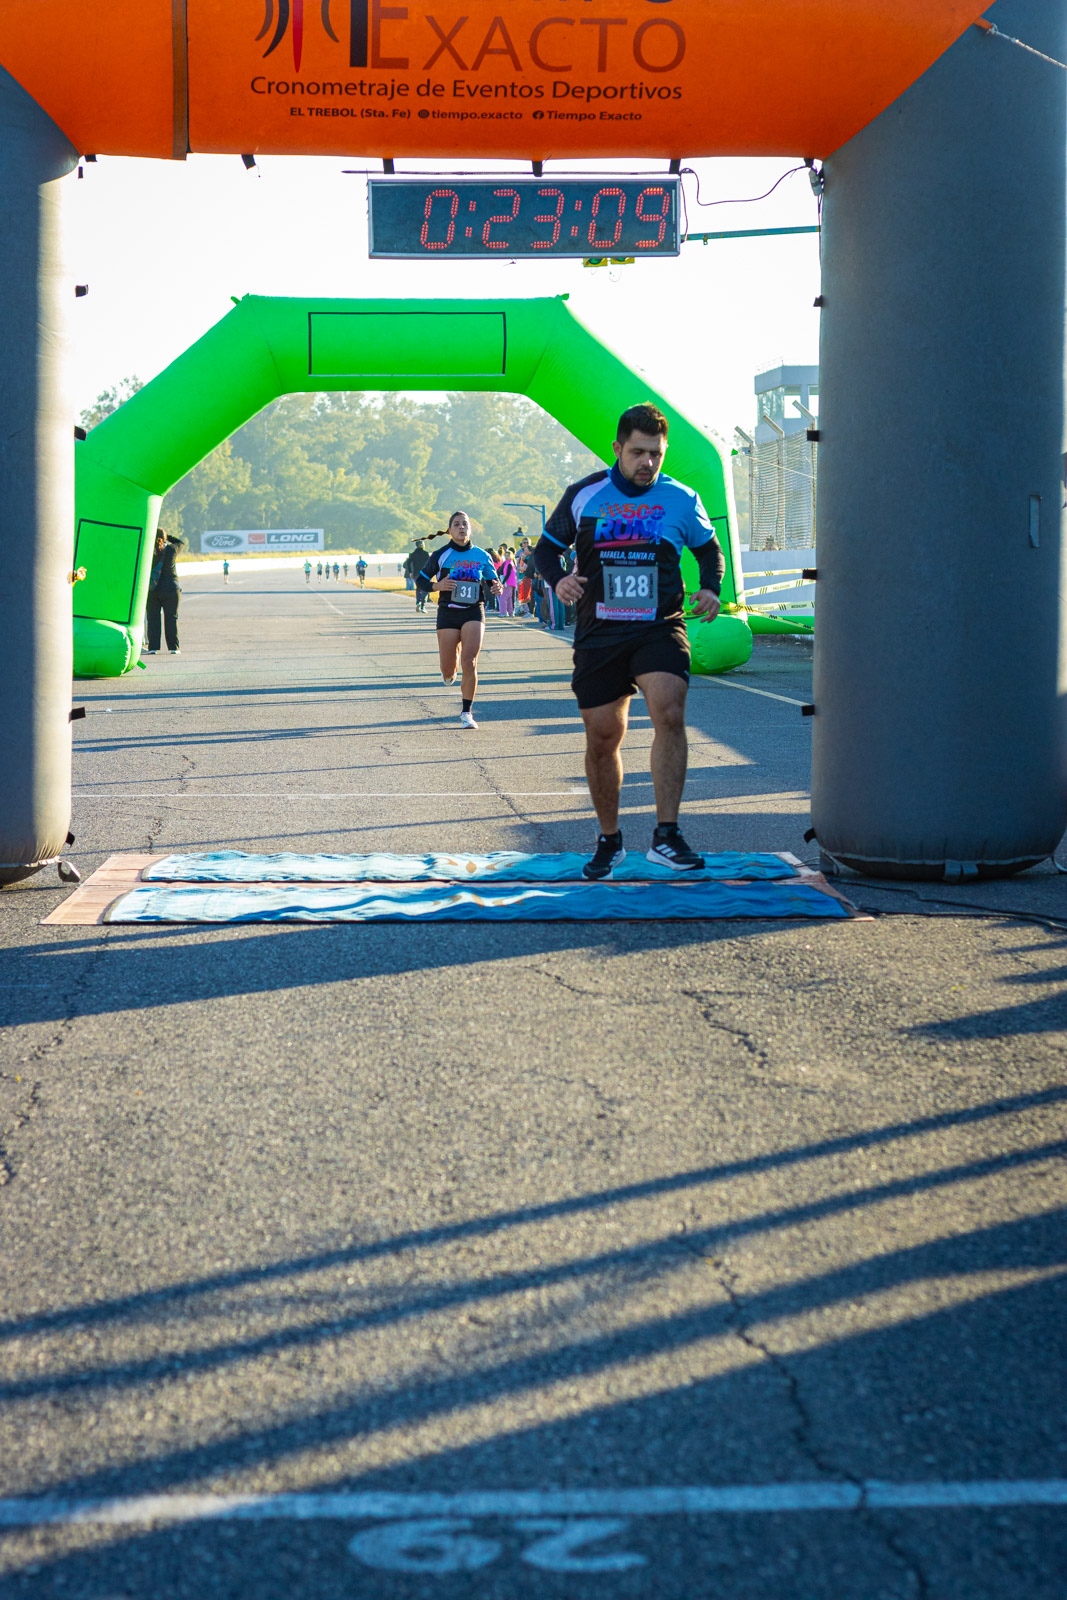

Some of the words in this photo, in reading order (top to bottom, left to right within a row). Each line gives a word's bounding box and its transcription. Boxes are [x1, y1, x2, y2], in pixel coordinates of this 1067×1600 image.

[371, 0, 687, 73] EXACTO
[250, 76, 410, 100] Cronometraje
[416, 78, 445, 98] de
[453, 80, 544, 98] Eventos
[552, 80, 682, 102] Deportivos
[289, 107, 304, 117] EL
[307, 107, 357, 118] TREBOL
[360, 108, 389, 119] (Sta.
[392, 108, 411, 119] Fe)
[431, 109, 523, 121] tiempo.exacto
[547, 110, 596, 122] Tiempo
[600, 111, 643, 121] Exacto
[420, 188, 670, 249] 0:23:09
[211, 535, 236, 546] Ford
[269, 534, 315, 542] LONG
[628, 551, 648, 560] SANTA
[648, 552, 656, 561] FE
[460, 585, 472, 598] 31
[614, 574, 649, 598] 128
